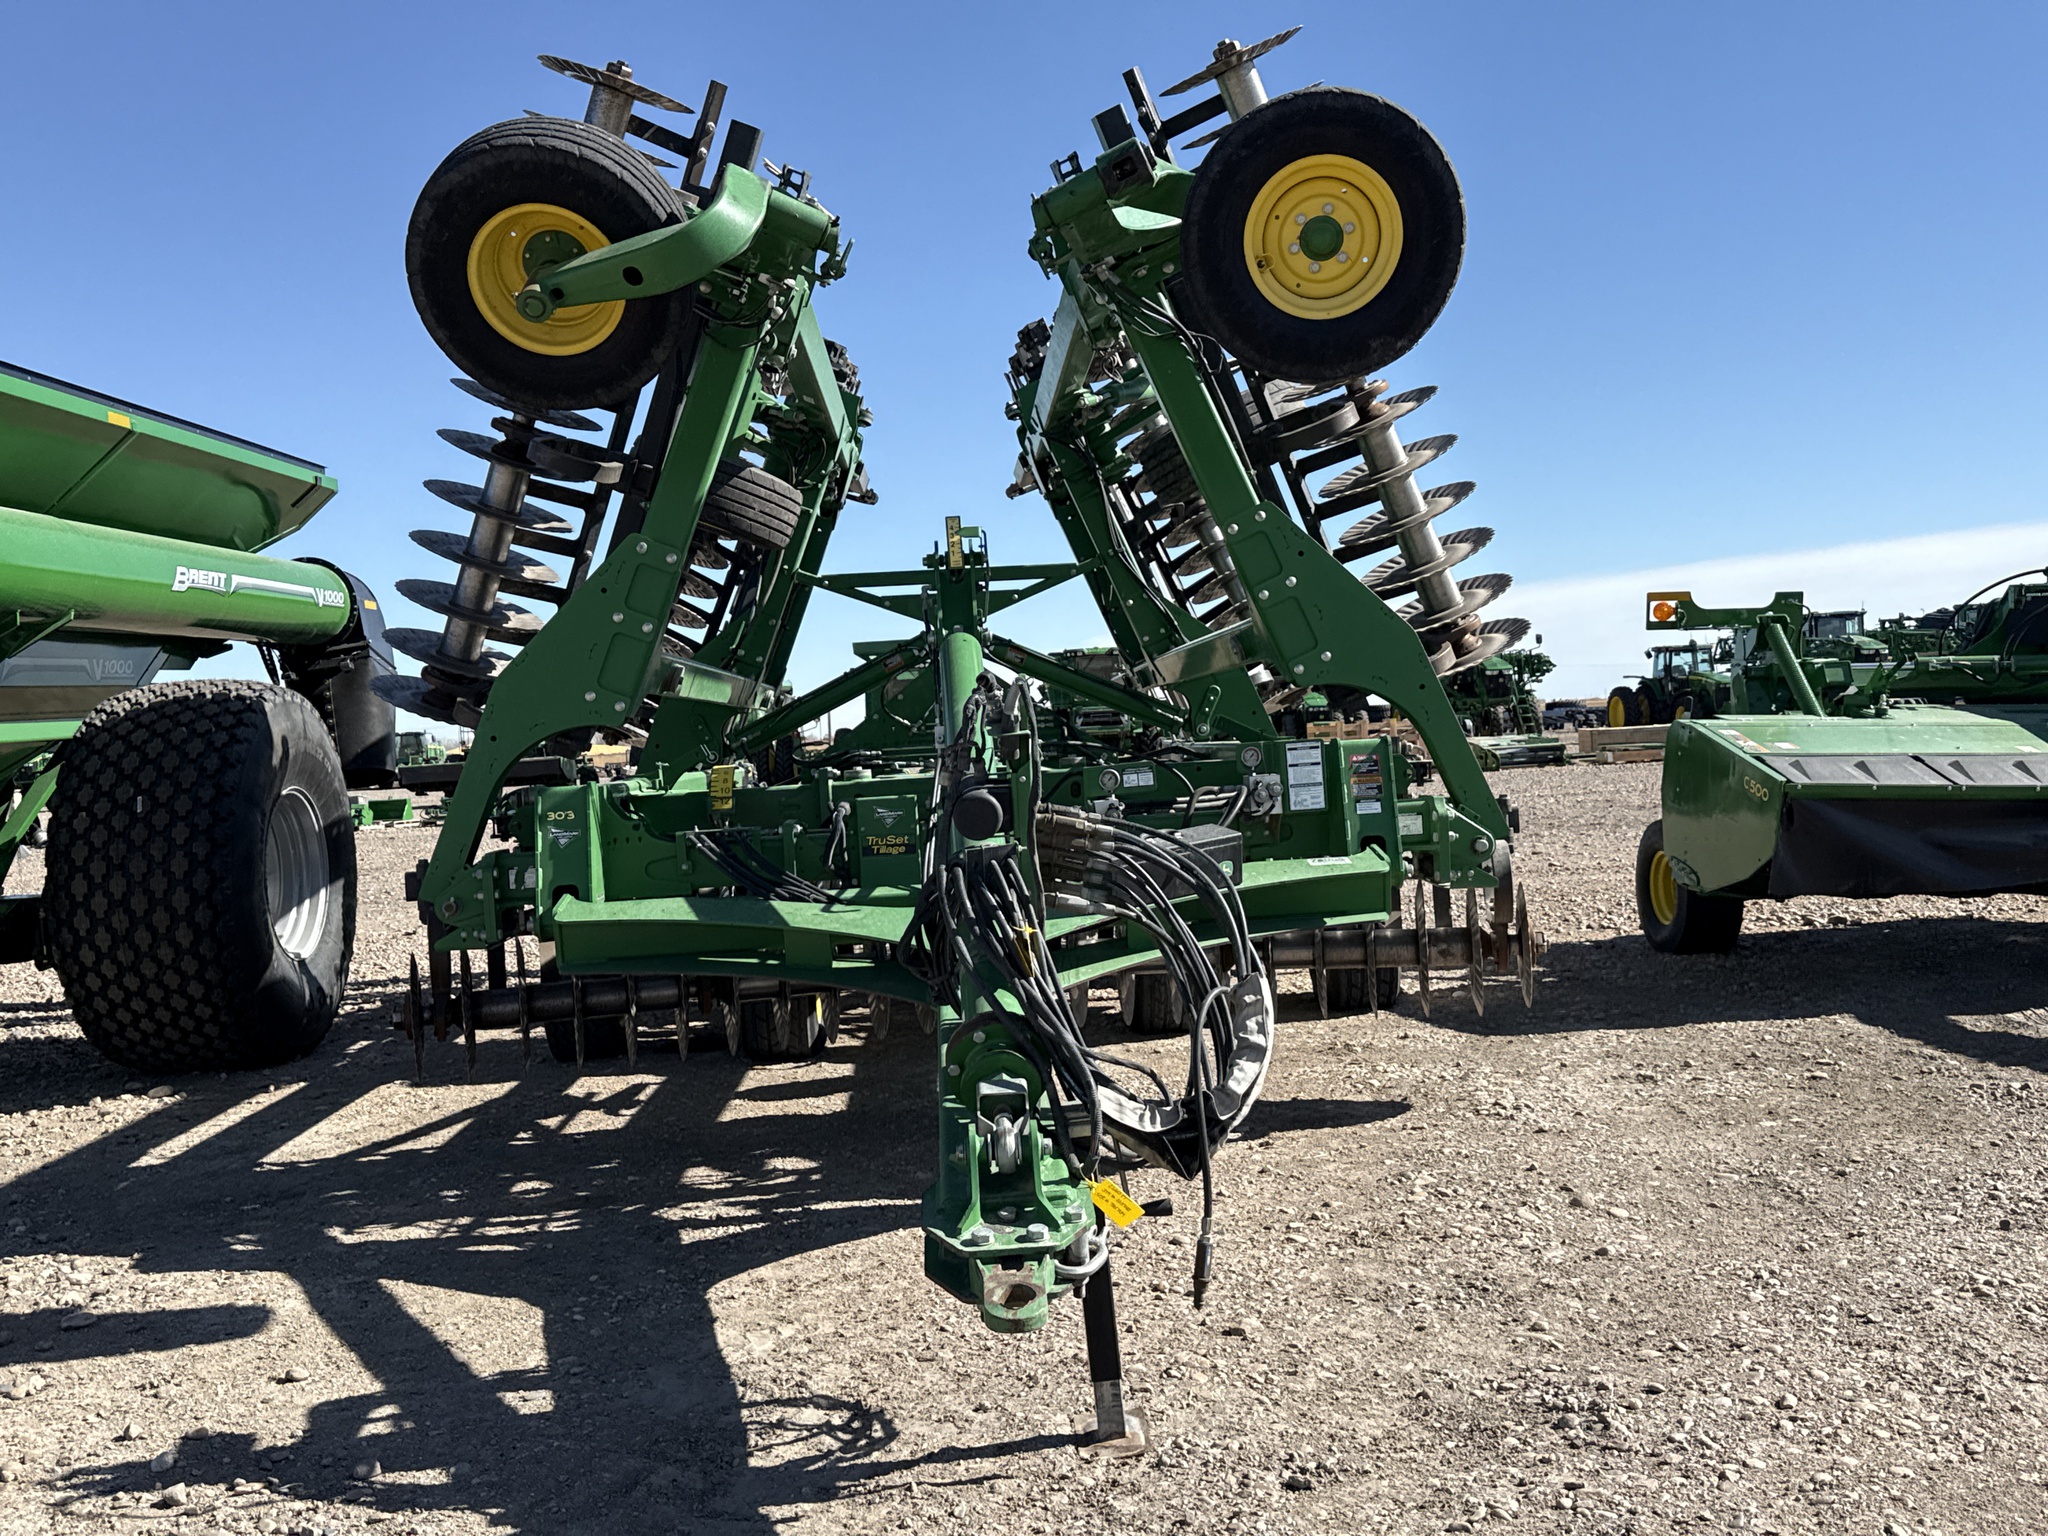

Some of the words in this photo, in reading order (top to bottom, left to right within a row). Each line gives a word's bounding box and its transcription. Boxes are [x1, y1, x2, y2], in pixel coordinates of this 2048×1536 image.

[171, 566, 228, 593] BRENT
[314, 587, 345, 608] V1000
[92, 658, 134, 682] V1000
[720, 786, 731, 794] 10
[1743, 776, 1769, 801] C500
[720, 797, 731, 805] 12
[546, 810, 575, 821] 303
[866, 835, 909, 846] TruSet
[871, 845, 906, 855] Tillage
